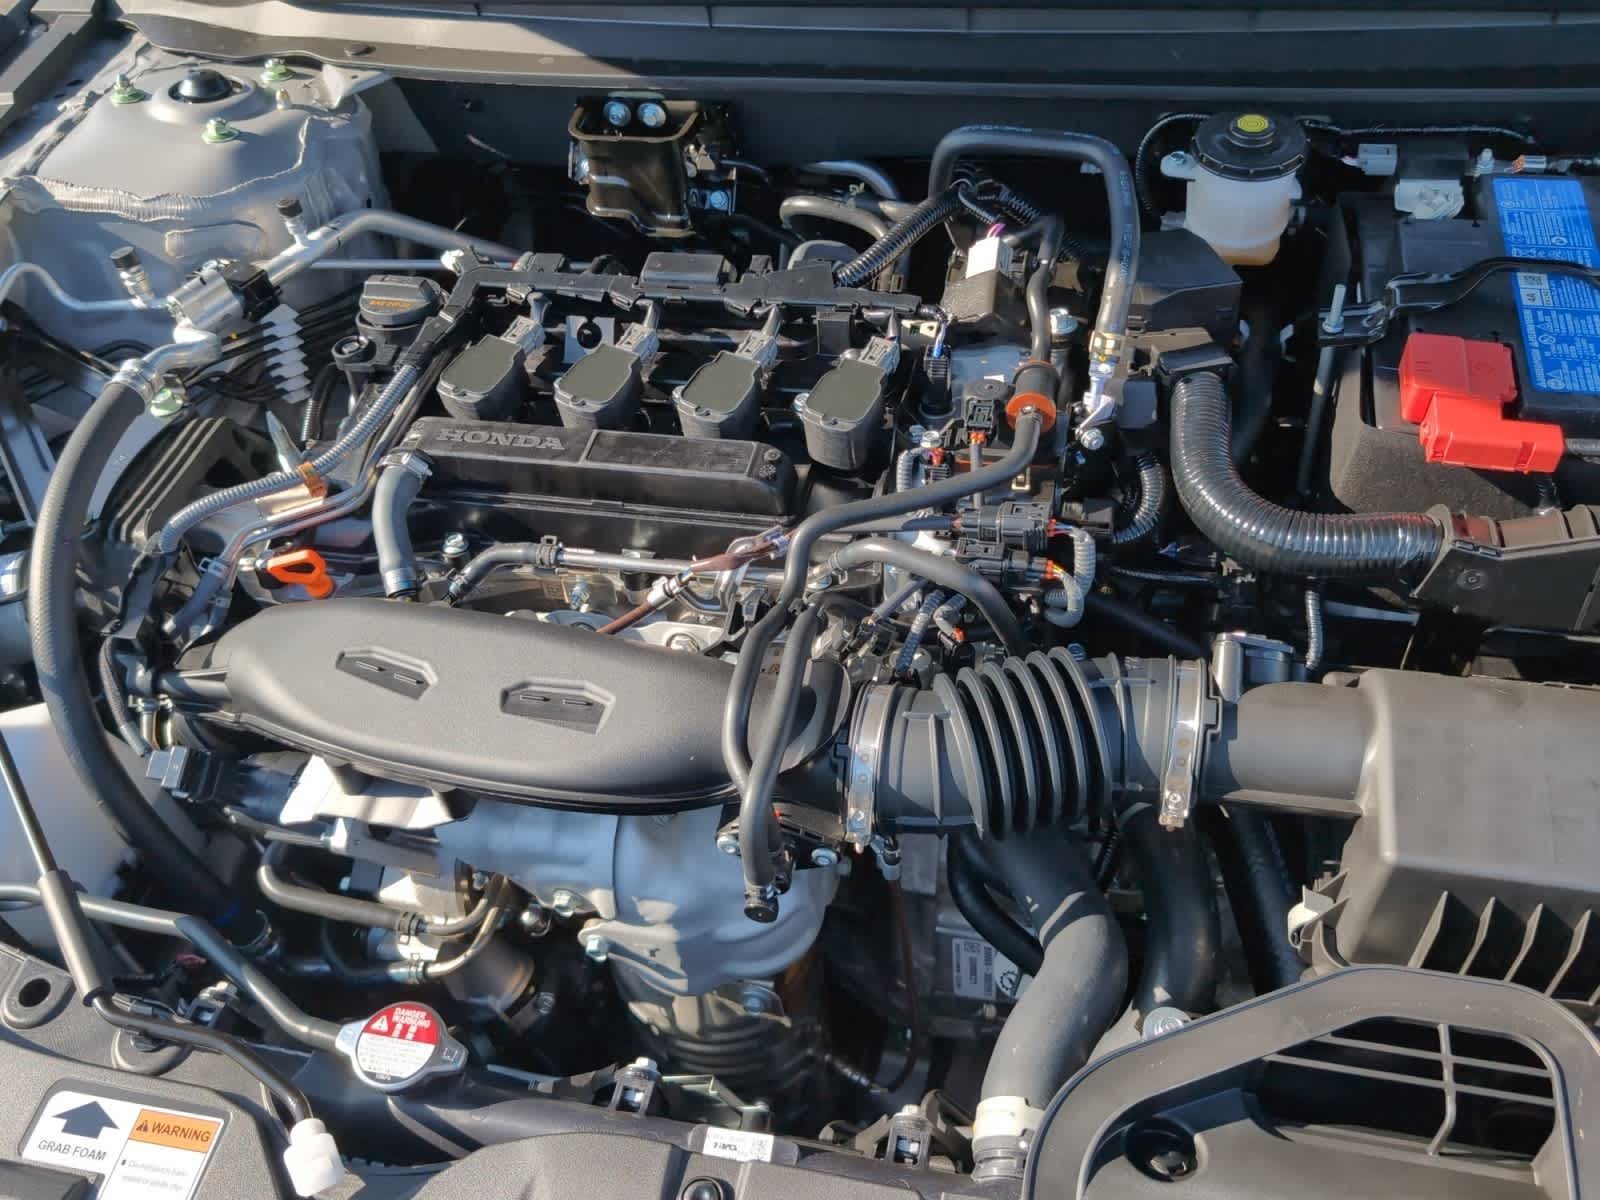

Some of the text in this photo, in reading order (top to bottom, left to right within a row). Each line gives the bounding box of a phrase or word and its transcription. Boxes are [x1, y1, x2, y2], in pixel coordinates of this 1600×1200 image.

[436, 428, 565, 450] HONDA
[392, 1015, 431, 1028] WARNING
[395, 1008, 427, 1019] DANGER
[152, 1122, 211, 1143] WARNING
[38, 1139, 107, 1161] GRAB FOAM
